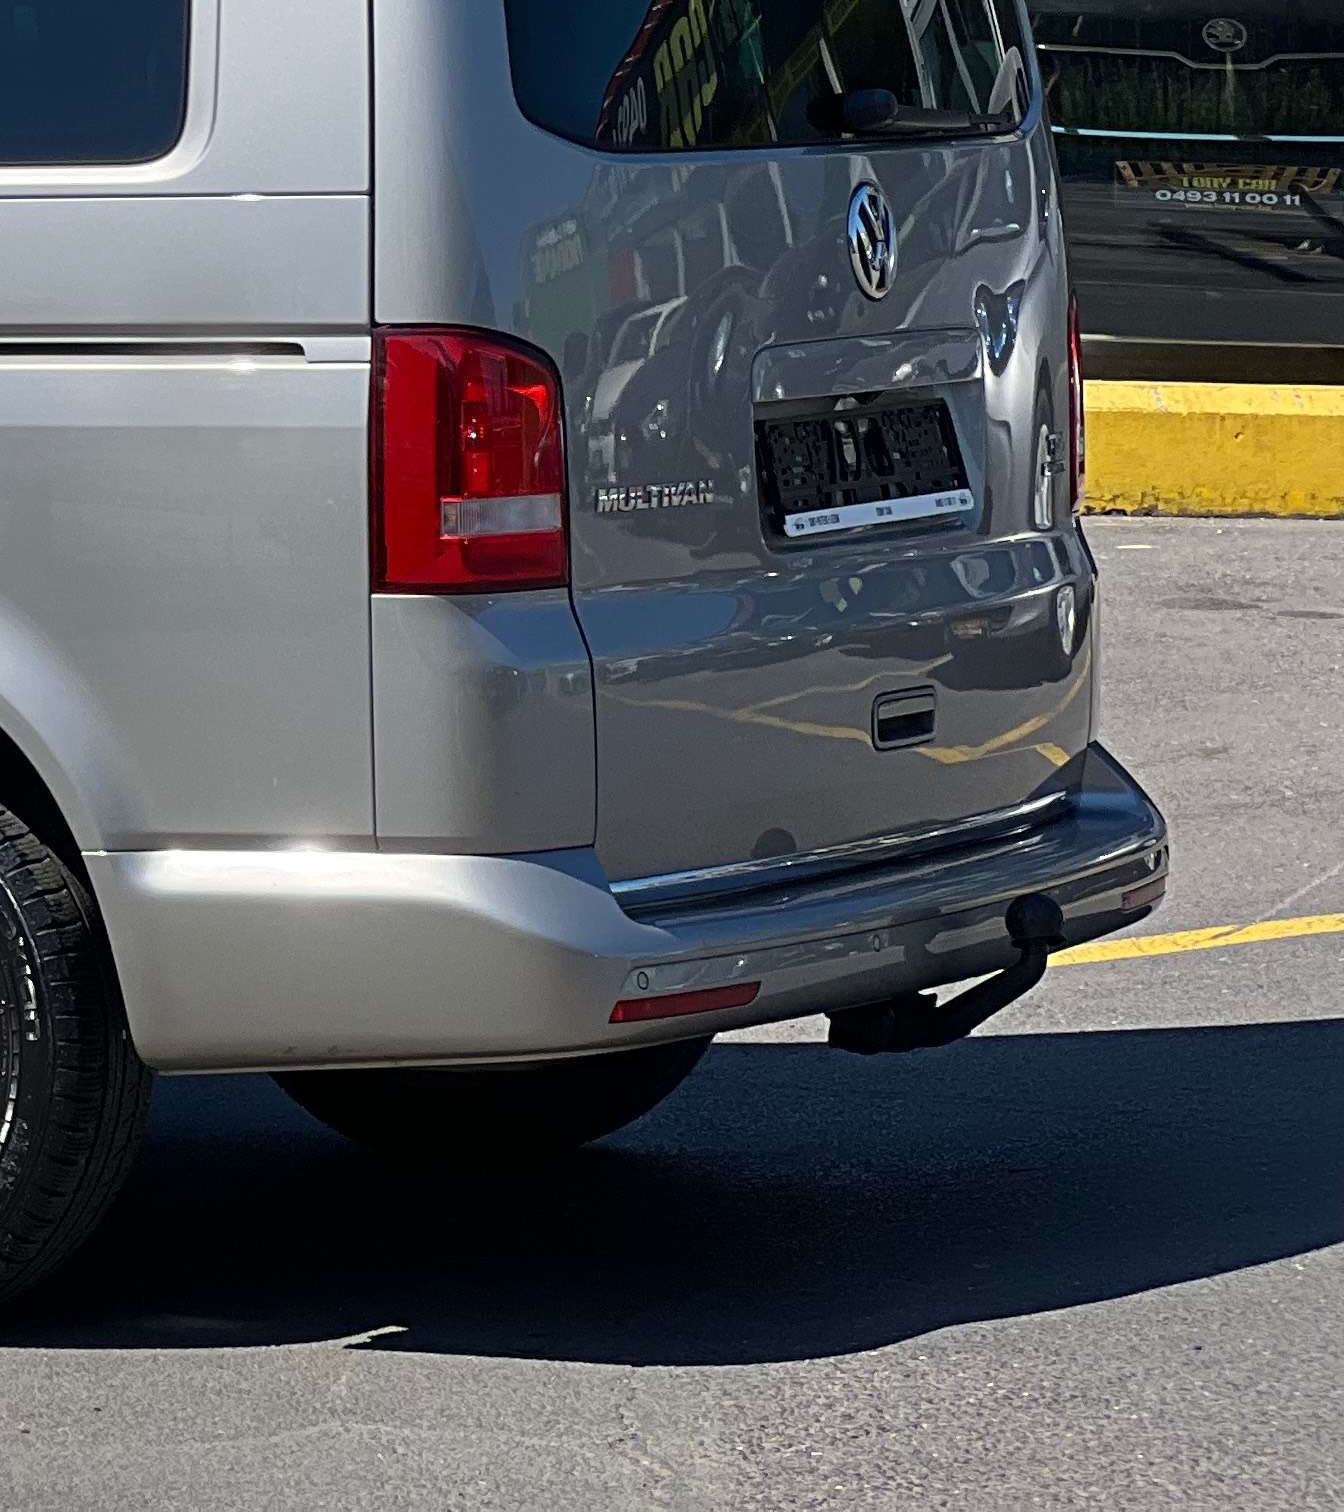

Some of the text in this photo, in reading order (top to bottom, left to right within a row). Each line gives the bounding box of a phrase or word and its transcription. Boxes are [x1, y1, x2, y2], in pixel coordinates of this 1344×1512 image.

[1155, 189, 1217, 202] 0493
[1223, 191, 1240, 204] 11
[1245, 192, 1279, 205] 00
[1283, 194, 1301, 207] 11
[596, 479, 714, 513] MULTIVAN
